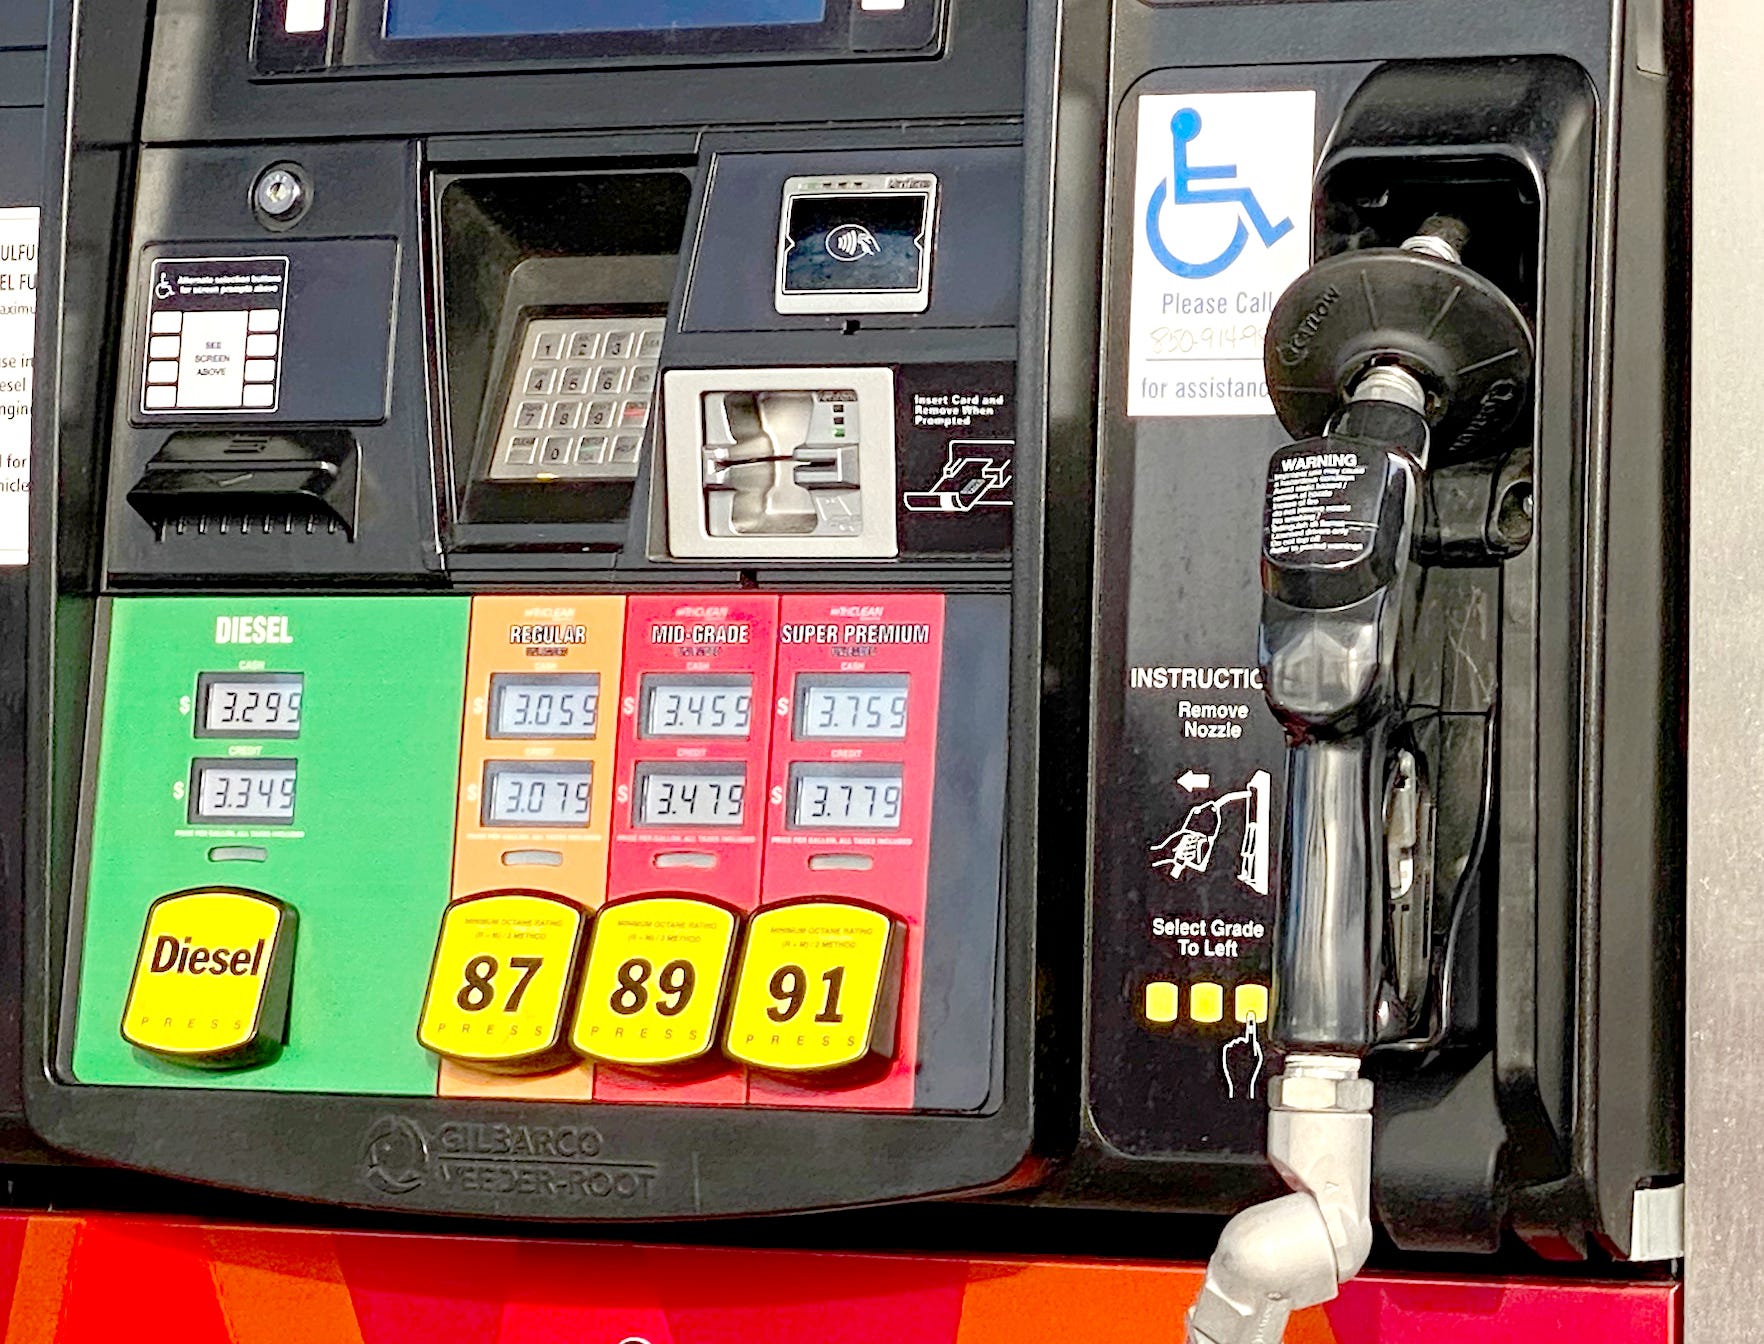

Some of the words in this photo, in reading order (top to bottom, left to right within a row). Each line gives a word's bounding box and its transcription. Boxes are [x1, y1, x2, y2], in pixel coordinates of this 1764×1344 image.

[1162, 292, 1227, 314] Please
[1236, 291, 1273, 314] Call
[195, 354, 230, 363] SCREEN
[545, 344, 551, 356] 1
[578, 344, 587, 356] 2
[612, 343, 621, 356] 3
[197, 368, 227, 376] ABOVE
[534, 380, 544, 391] 4
[568, 378, 578, 391] 5
[603, 377, 612, 390] 6
[1142, 377, 1168, 398] for
[914, 394, 948, 405] Insert
[951, 394, 980, 405] Card
[982, 394, 1005, 405] and
[0, 400, 32, 420] ngin
[525, 413, 536, 426] 7
[559, 413, 570, 426] 8
[594, 412, 604, 425] 9
[914, 405, 960, 416] Remove
[962, 405, 995, 416] When
[914, 416, 972, 428] Prompted
[7, 454, 27, 468] for
[551, 448, 560, 460] 0
[1281, 454, 1358, 472] WARNING
[214, 615, 294, 645] DIESEL
[510, 624, 587, 644] REGULAR
[652, 624, 750, 644] MID-GRADE
[781, 624, 839, 644] SUPER
[843, 624, 930, 644] PREMIUM
[840, 662, 865, 671] CASH
[179, 695, 191, 716] $
[222, 692, 301, 723] 3.299
[472, 697, 485, 715] $
[514, 694, 599, 726] 3.059
[623, 696, 635, 715] $
[664, 694, 752, 727] 3.459
[776, 697, 789, 716] $
[819, 696, 907, 728] 3.759
[1178, 700, 1250, 719] Remove
[1184, 720, 1243, 739] Nozzle
[228, 746, 263, 756] CREDIT
[831, 749, 863, 758] CREDIT
[173, 780, 185, 800] $
[214, 778, 295, 809] 3.349
[466, 784, 478, 801] $
[506, 782, 591, 814] 3.079
[618, 785, 629, 802] $
[658, 784, 745, 816] 3.479
[771, 785, 783, 805] $
[812, 786, 900, 819] 3.779
[1152, 918, 1207, 937] Select
[1210, 919, 1265, 939] Grade
[150, 935, 266, 976] Diesel
[1178, 939, 1200, 957] To
[1204, 939, 1239, 958] Left
[457, 955, 545, 1013] 87
[610, 958, 696, 1017] 89
[766, 965, 845, 1023] 91
[141, 1016, 241, 1030] PRESS
[438, 1022, 543, 1037] PRESS
[590, 1026, 698, 1041] PRESS
[746, 1034, 855, 1047] PRESS
[439, 1122, 604, 1157] GILBARCO
[437, 1163, 658, 1198] VEEDER-ROOT
